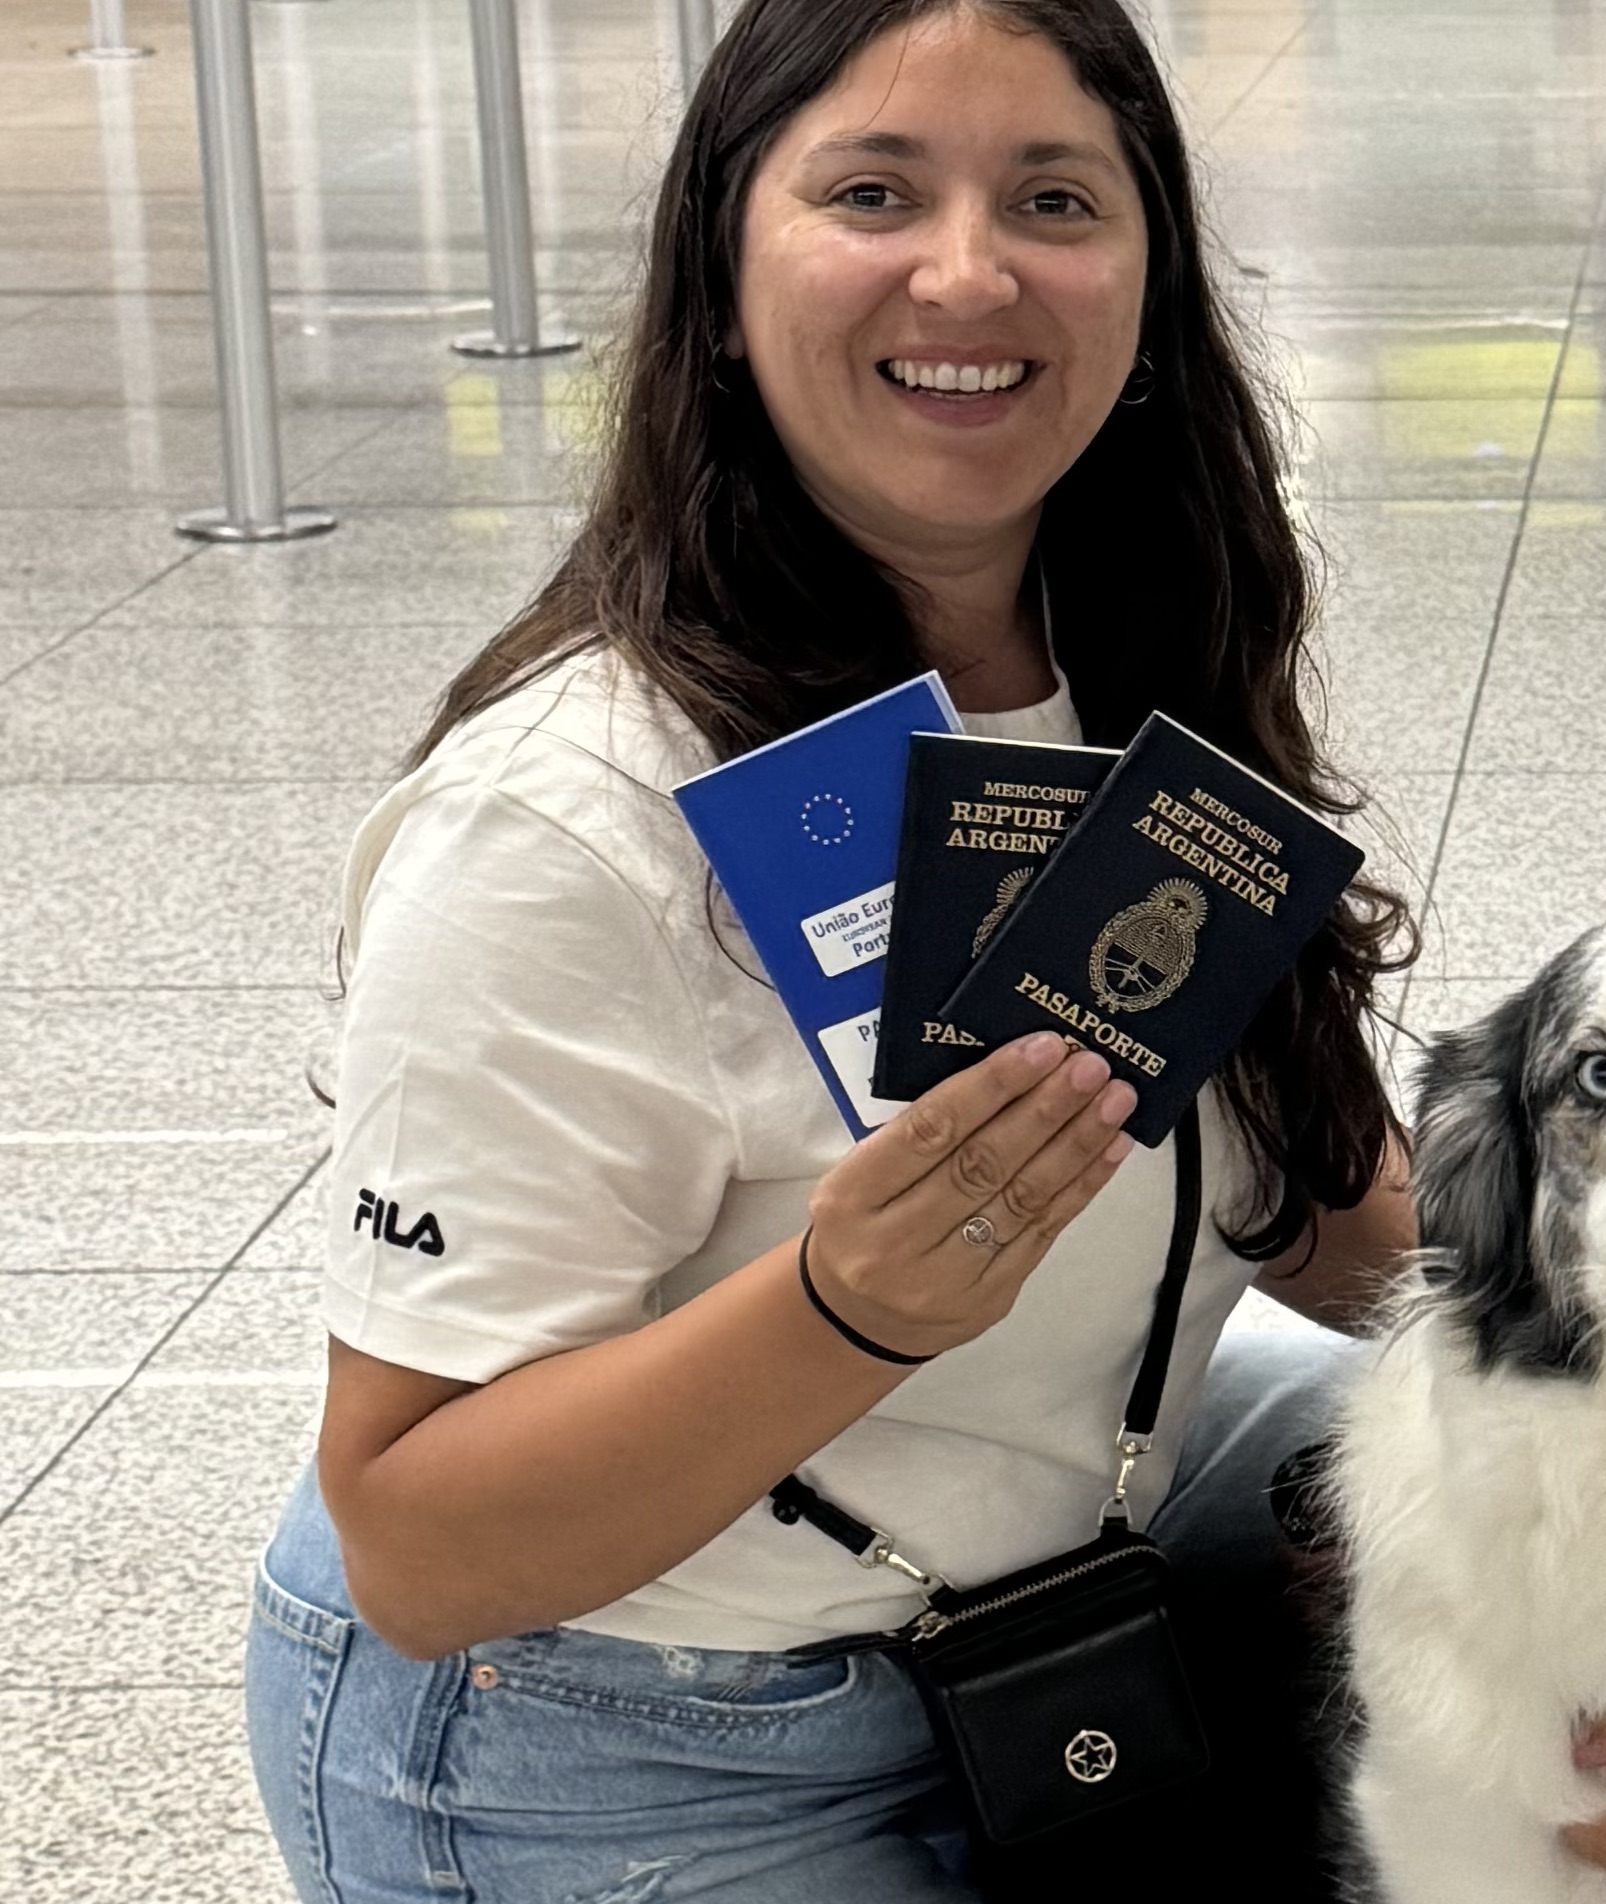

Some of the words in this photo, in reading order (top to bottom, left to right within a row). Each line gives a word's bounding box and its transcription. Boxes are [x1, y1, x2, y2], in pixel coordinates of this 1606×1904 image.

[946, 828, 1058, 855] ARGEN
[950, 800, 1070, 831] REPUBL
[1189, 787, 1283, 855] MERCOSUR
[1132, 815, 1276, 916] ARGENTINA
[811, 912, 860, 938] União
[1015, 972, 1167, 1078] PASAPORTE
[354, 1188, 445, 1257] FILA
